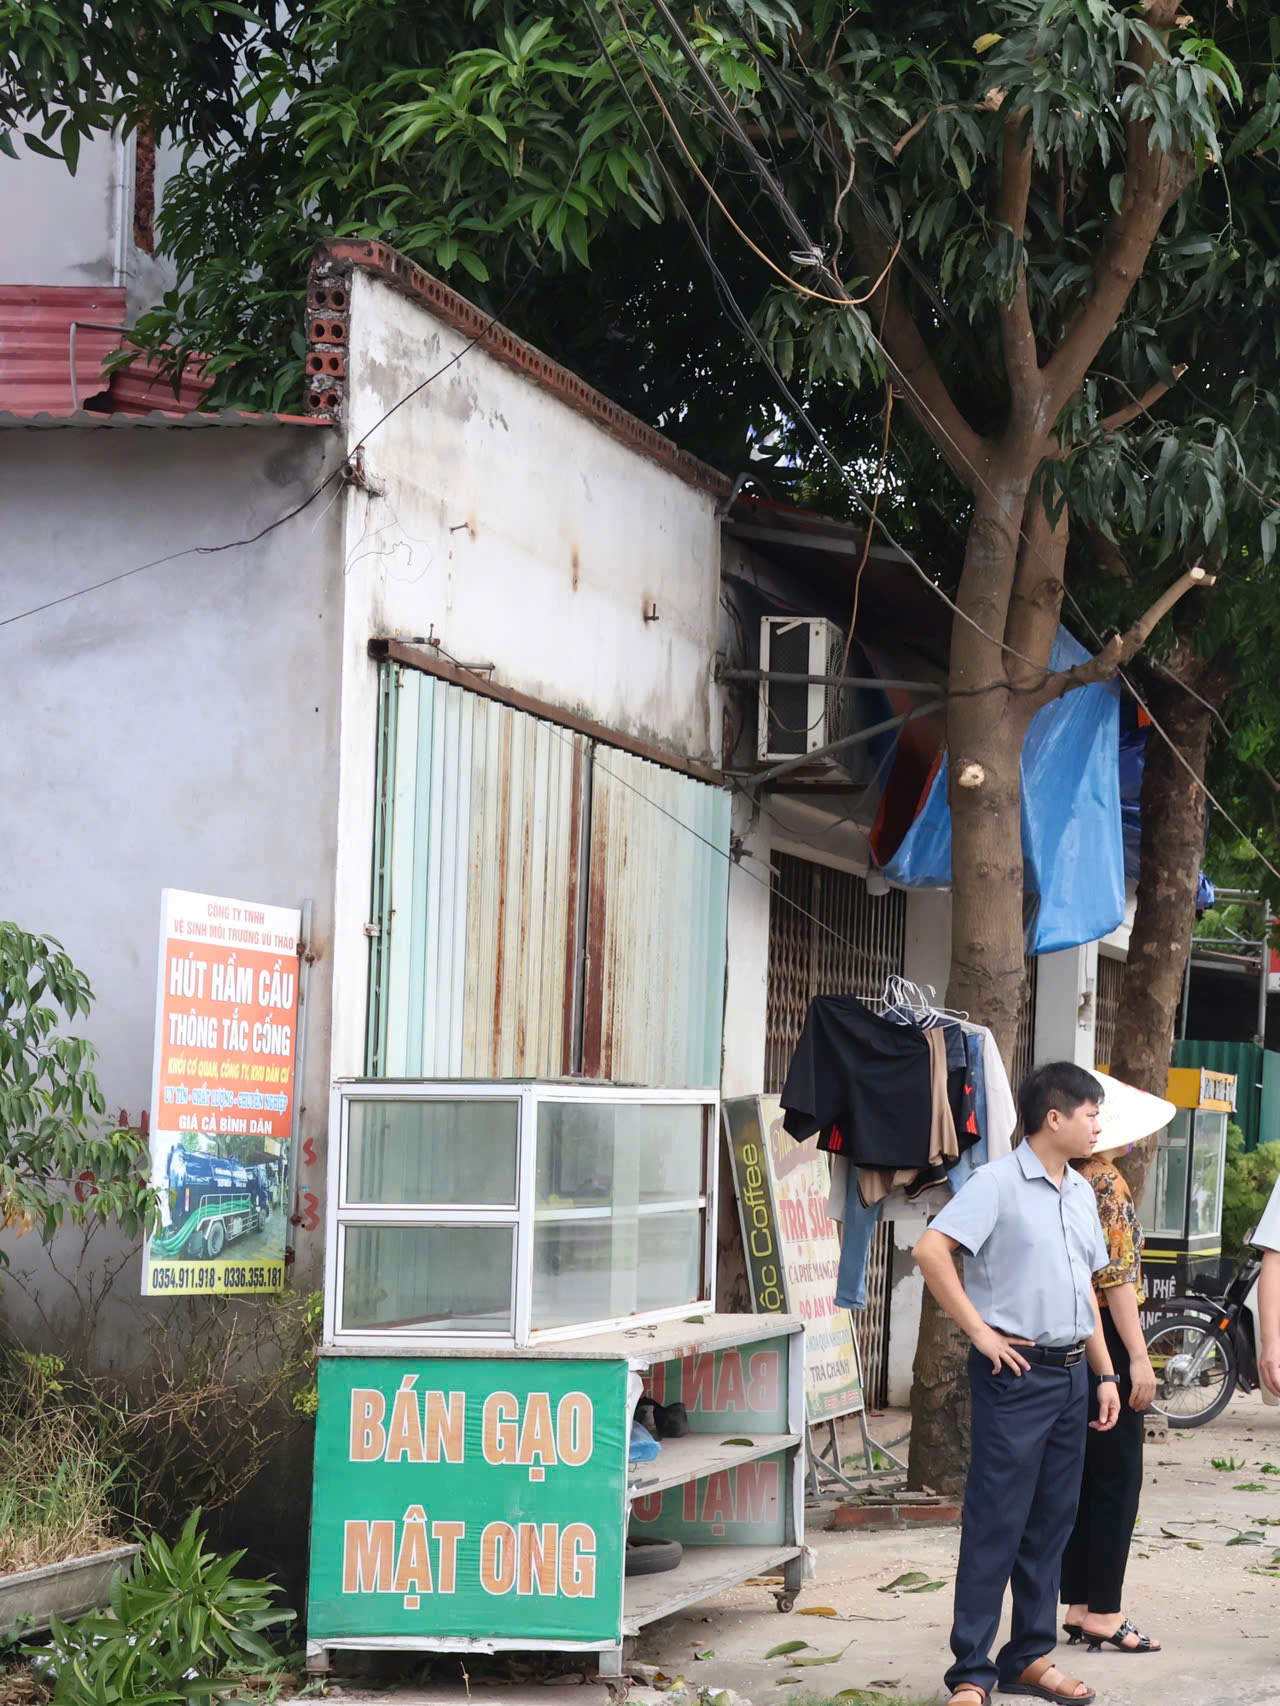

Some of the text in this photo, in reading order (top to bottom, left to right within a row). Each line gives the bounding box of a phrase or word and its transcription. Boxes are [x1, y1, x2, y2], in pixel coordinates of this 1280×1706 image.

[232, 907, 243, 921] TY
[244, 909, 265, 925] TNHH
[187, 920, 207, 937] SINH
[169, 952, 295, 1010] HÚT HẦM CẦU
[169, 1008, 291, 1057] THÔNG TẮC CỐNG
[178, 1111, 273, 1135] GIÁ CẢ BÌNH DÂN
[743, 1143, 785, 1315] ộc Coffee
[224, 1267, 282, 1288] 0336.355.181
[1153, 1275, 1176, 1299] PHÊ
[1140, 1311, 1162, 1330] ANG
[826, 1358, 849, 1380] CHANH
[349, 1374, 594, 1482] BÁN GẠO
[342, 1504, 596, 1610] MẬT ONG
